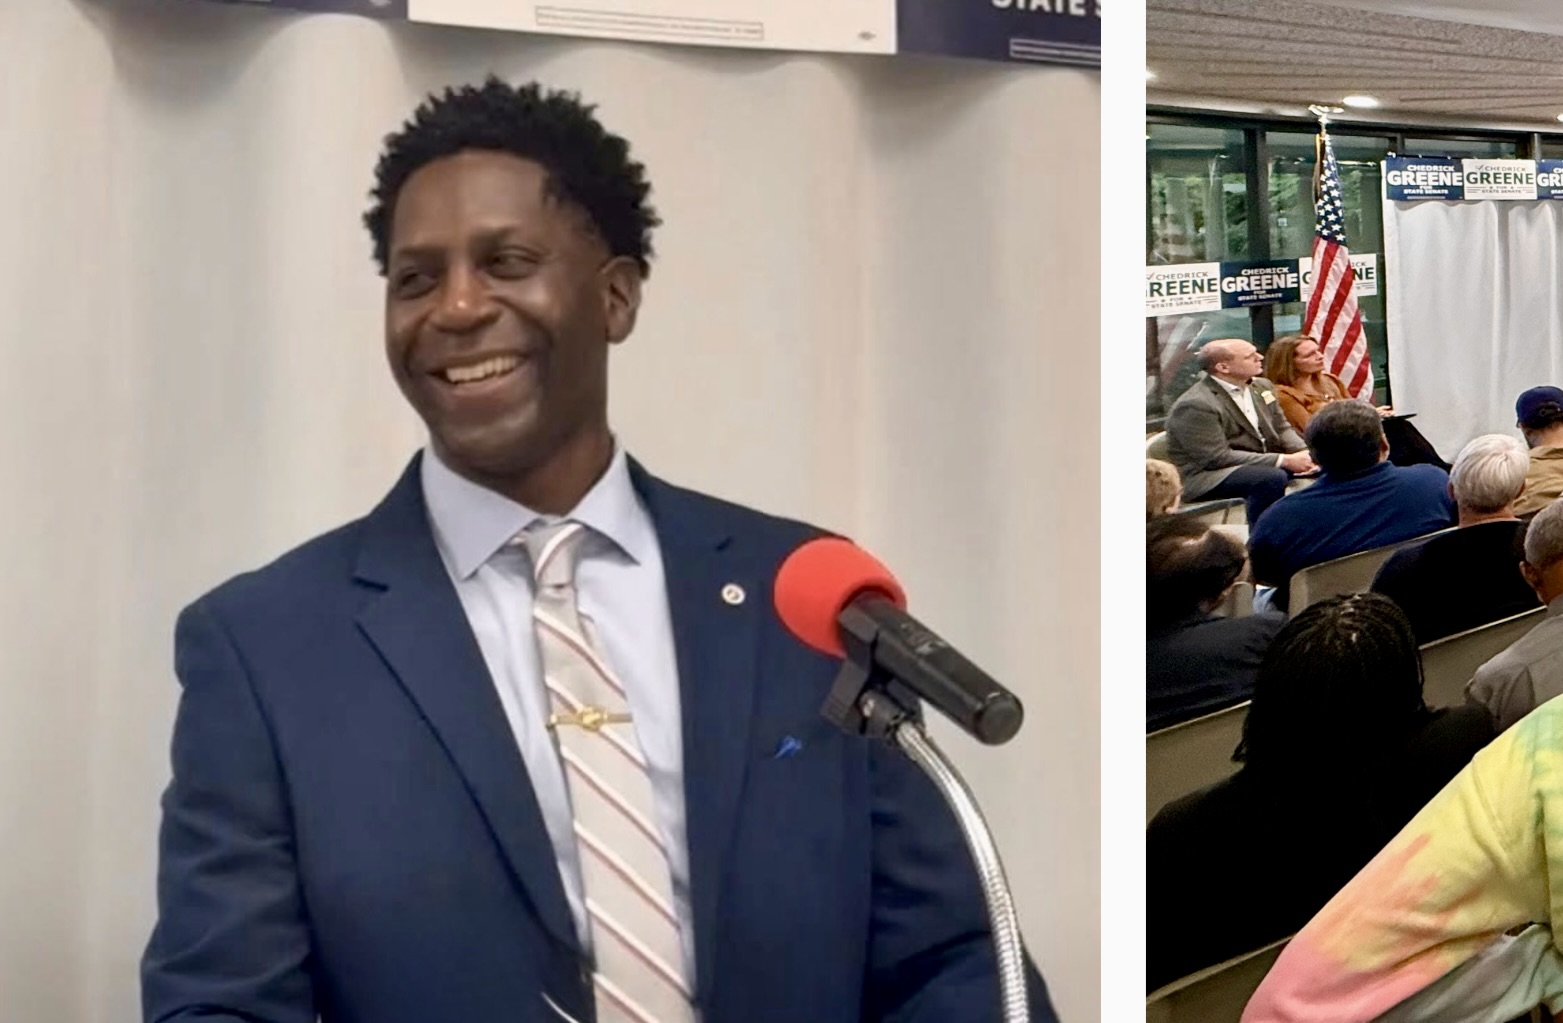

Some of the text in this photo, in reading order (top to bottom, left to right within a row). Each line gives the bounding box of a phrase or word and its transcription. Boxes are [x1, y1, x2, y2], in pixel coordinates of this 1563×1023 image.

[1387, 171, 1463, 186] GREENE
[1466, 172, 1535, 185] GREENE
[1155, 271, 1209, 281] CHEDRICK
[1241, 267, 1290, 276] CHEDRICK
[1146, 278, 1218, 298] REENE
[1221, 273, 1299, 293] GREENE
